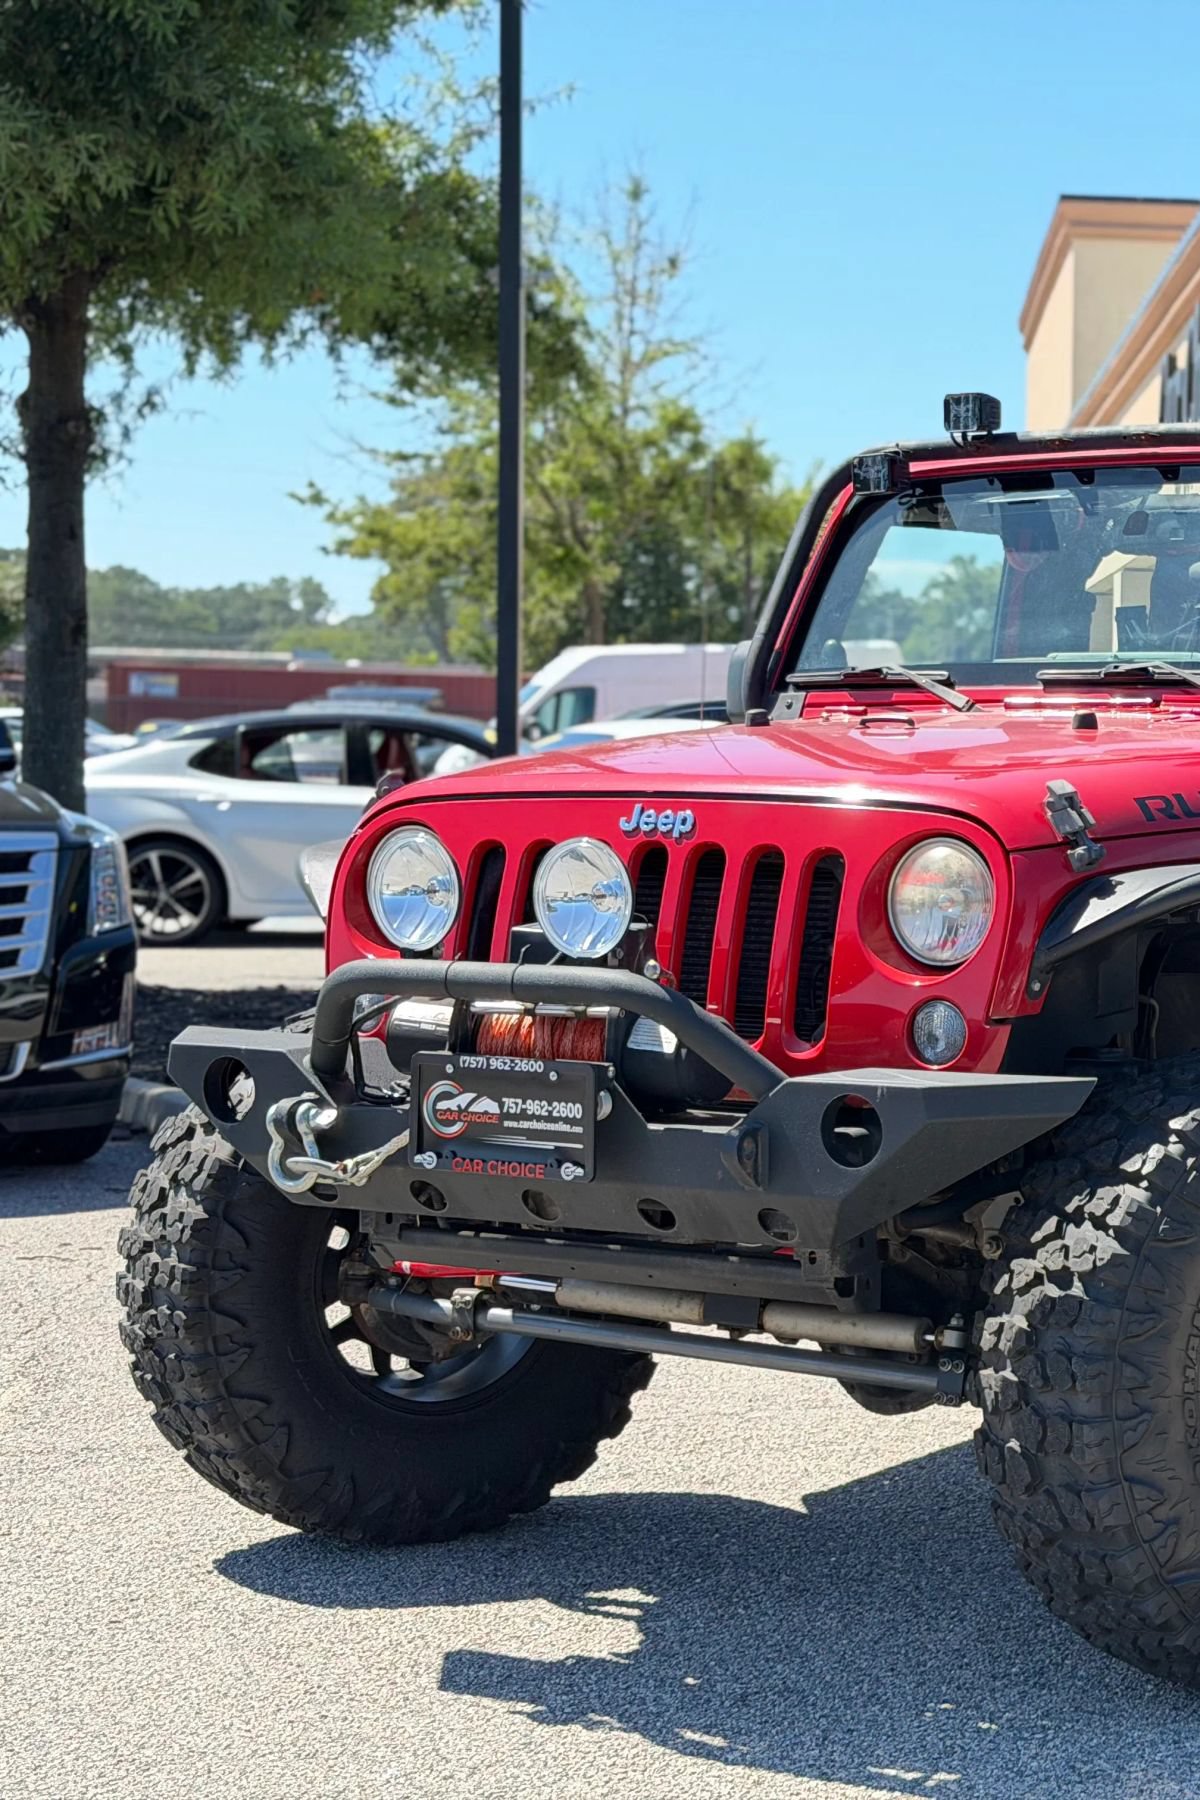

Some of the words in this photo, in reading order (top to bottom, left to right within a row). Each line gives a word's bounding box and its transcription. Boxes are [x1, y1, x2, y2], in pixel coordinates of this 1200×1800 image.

[619, 803, 695, 838] Jeep
[459, 1055, 486, 1070] (757)
[489, 1058, 544, 1073] 962-2600
[436, 1110, 459, 1120] CAR
[460, 1112, 499, 1124] CHOICE
[501, 1097, 583, 1119] 757-962-2600
[452, 1157, 483, 1174] CAR
[487, 1160, 545, 1179] CHOICE
